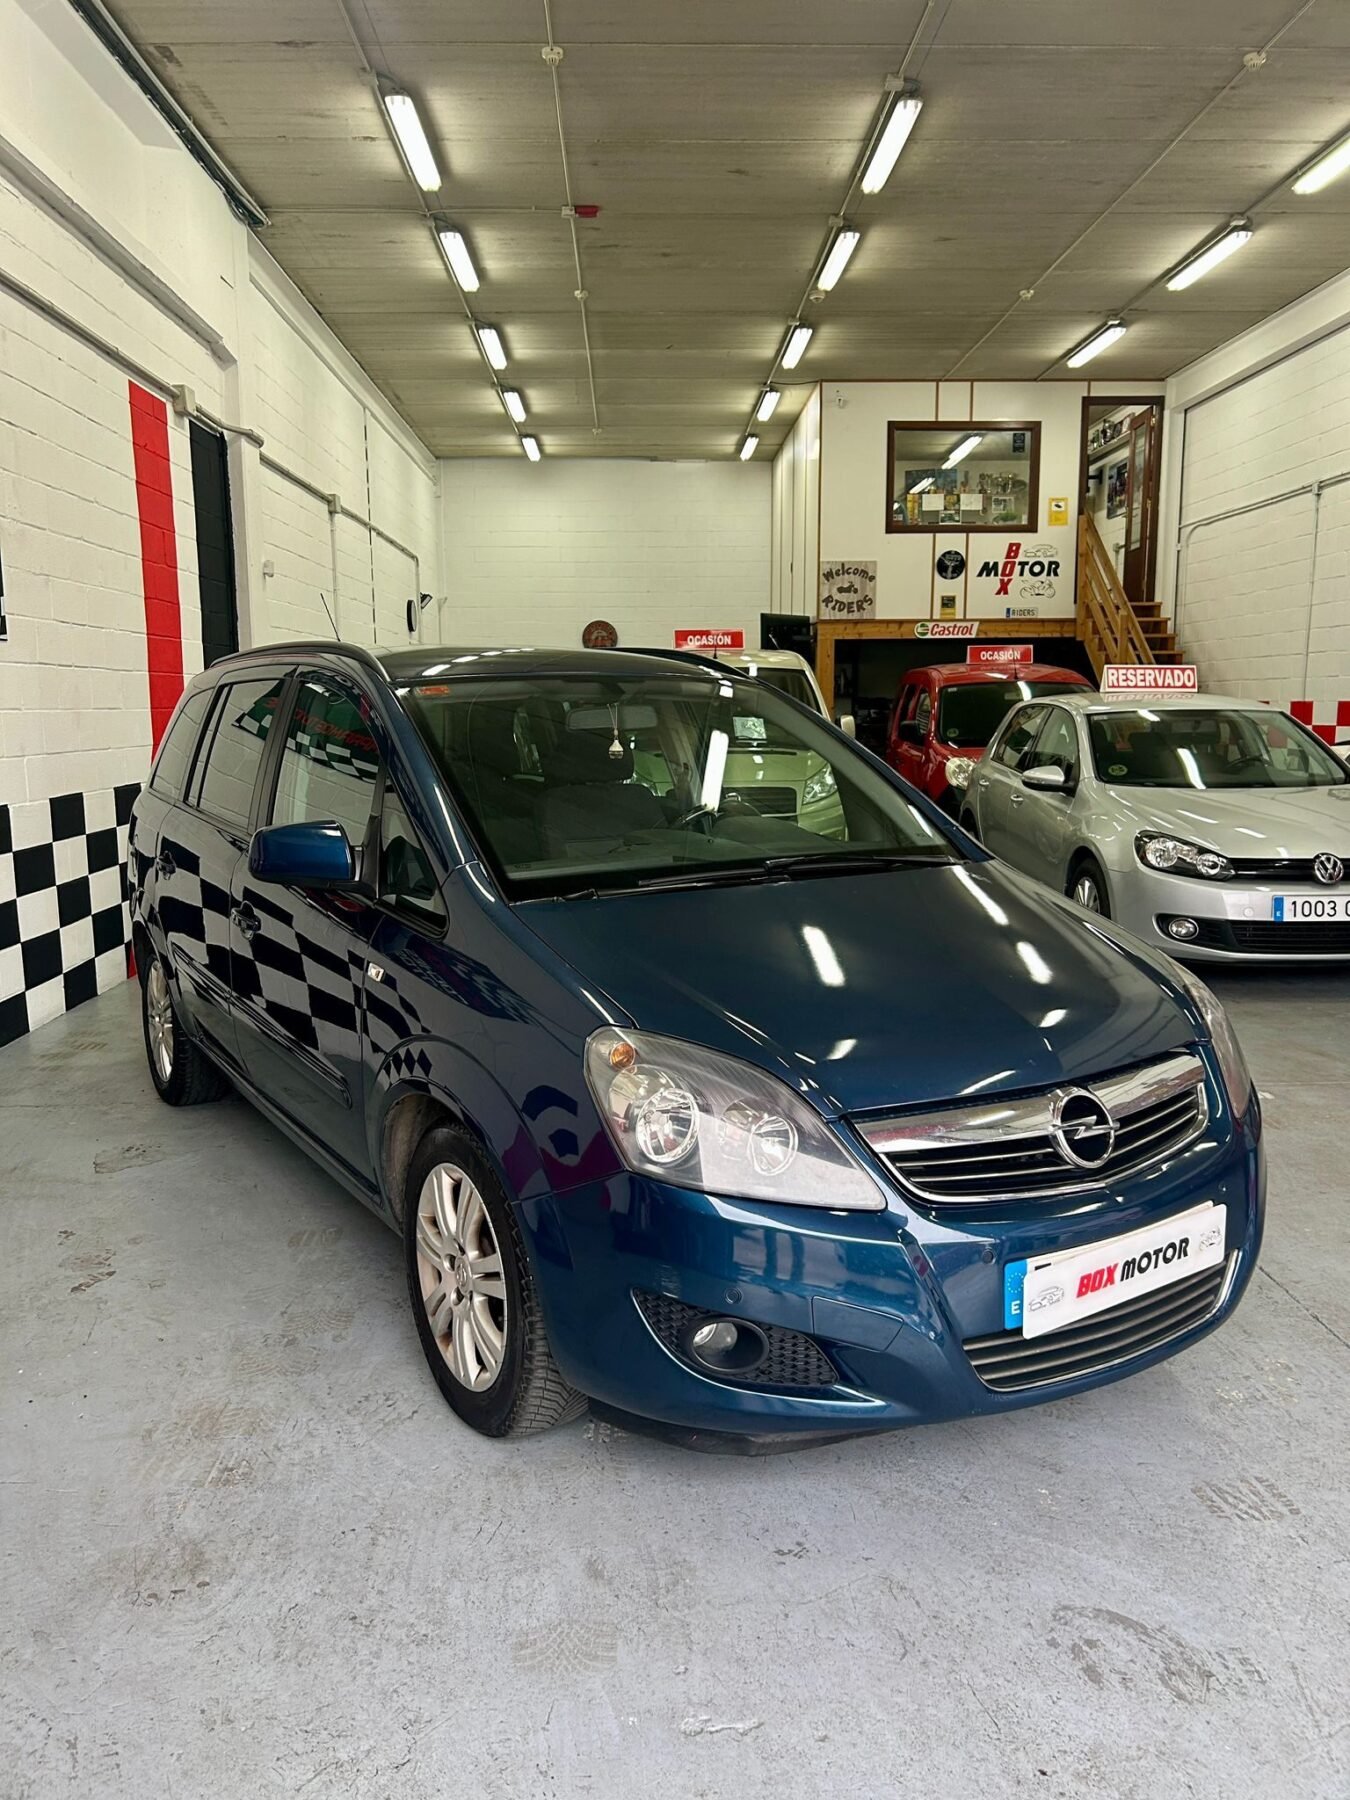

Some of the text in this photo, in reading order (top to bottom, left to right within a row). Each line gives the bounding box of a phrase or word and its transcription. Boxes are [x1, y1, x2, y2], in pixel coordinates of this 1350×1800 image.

[822, 562, 876, 582] Welcome
[976, 560, 1060, 578] MOTOR
[995, 543, 1021, 595] BOX
[822, 594, 874, 614] RIDERS
[687, 632, 732, 646] OCASIÓN
[930, 624, 974, 636] Castrol
[980, 648, 1021, 660] OCASIÓN
[1108, 667, 1195, 688] RESERVADO
[1291, 900, 1337, 918] 1003
[1076, 1237, 1190, 1298] BOX MOTOR
[1011, 1300, 1021, 1315] E
